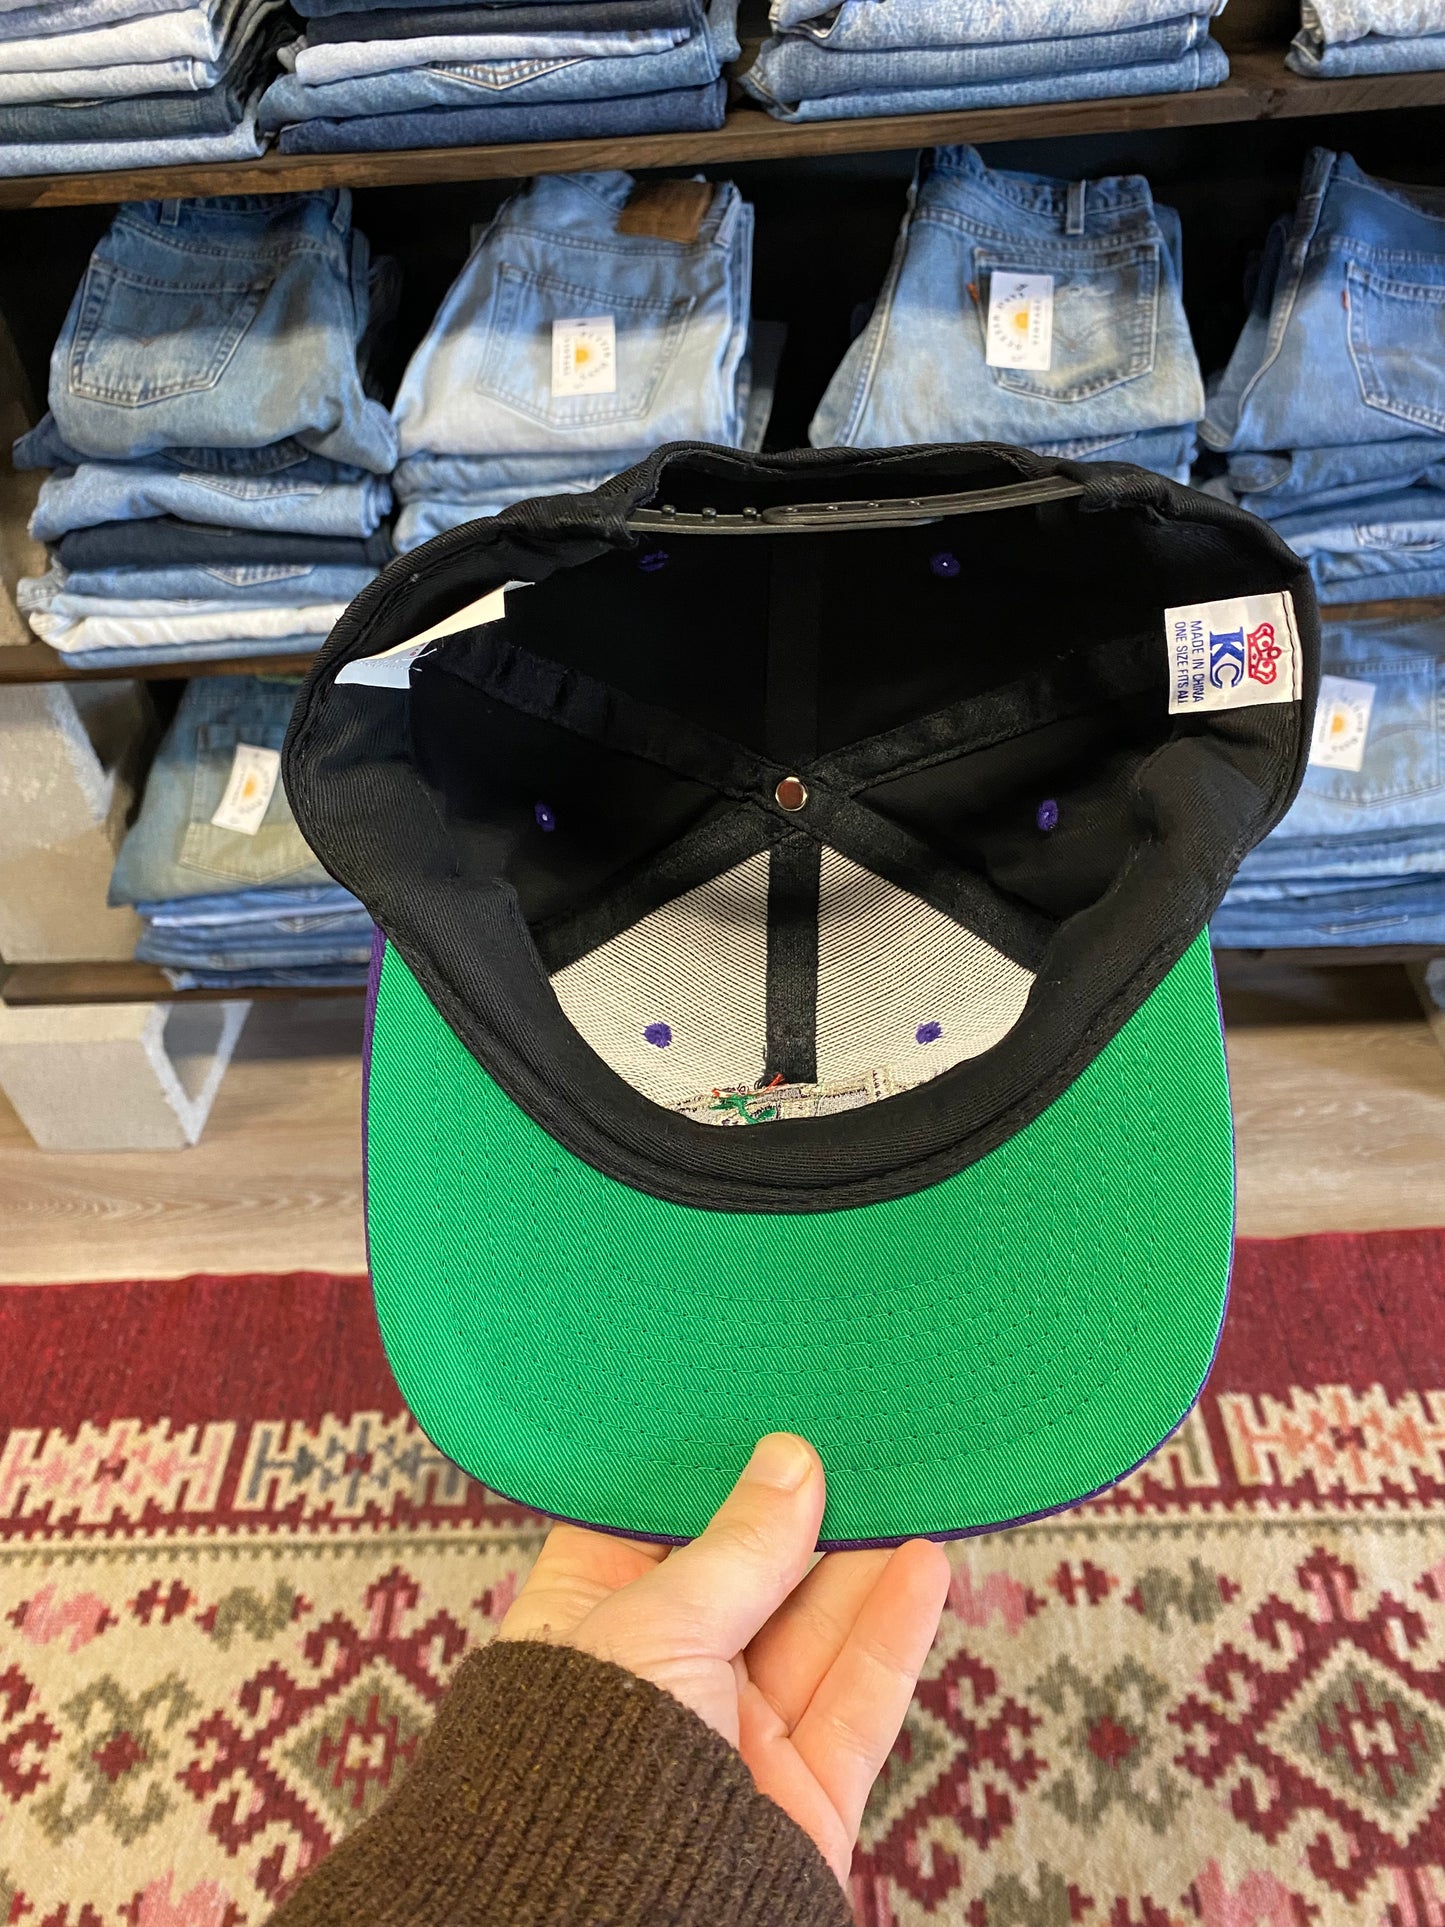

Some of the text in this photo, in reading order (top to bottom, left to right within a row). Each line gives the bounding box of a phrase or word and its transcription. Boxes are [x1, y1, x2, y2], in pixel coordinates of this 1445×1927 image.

[1174, 621, 1188, 642] ONE
[1176, 646, 1189, 668] SIZE
[1190, 620, 1206, 703] MADE IN CHINA
[1209, 626, 1245, 689] KC
[1177, 668, 1189, 688] FITS
